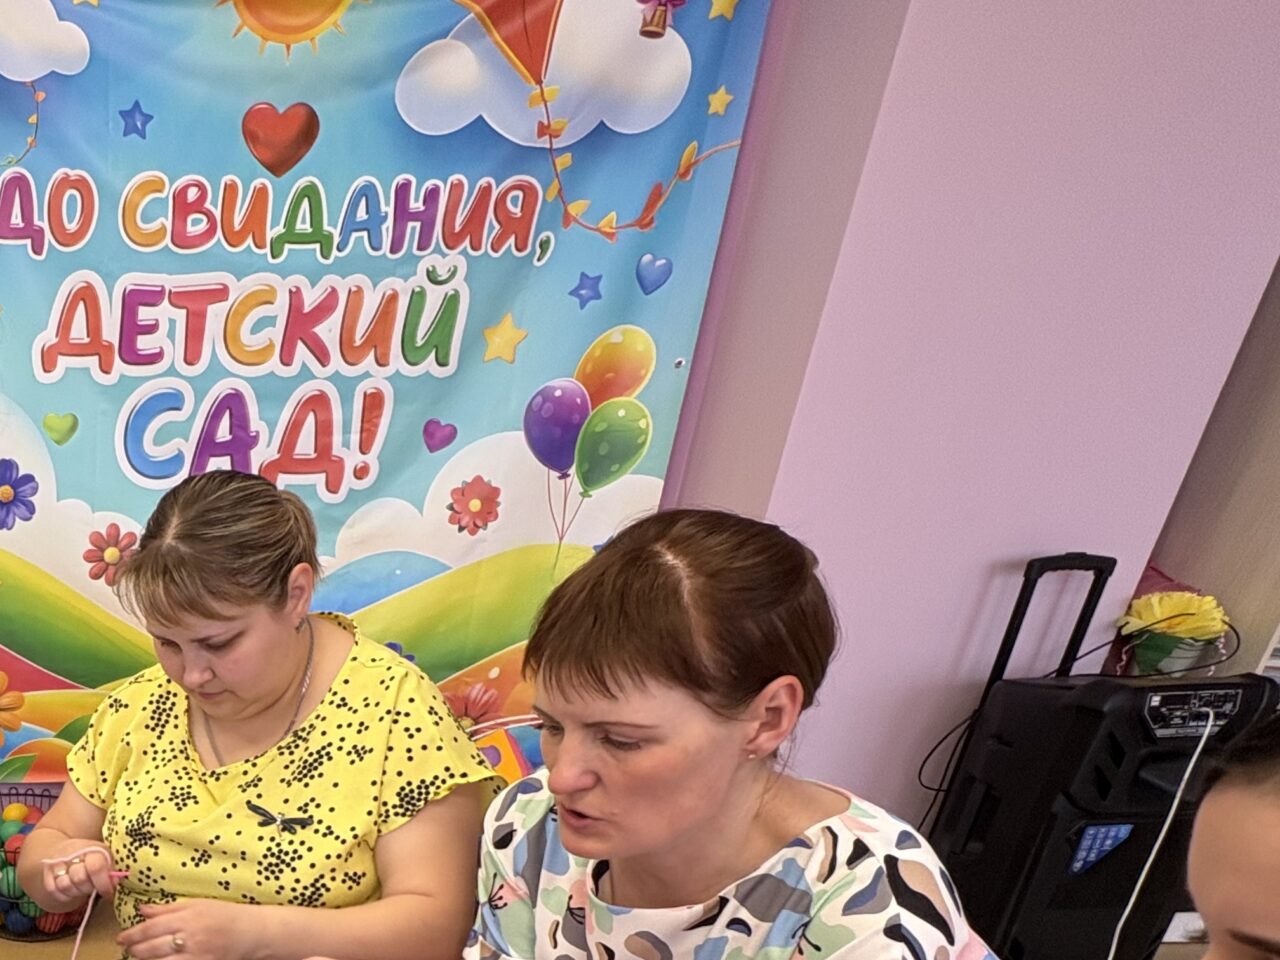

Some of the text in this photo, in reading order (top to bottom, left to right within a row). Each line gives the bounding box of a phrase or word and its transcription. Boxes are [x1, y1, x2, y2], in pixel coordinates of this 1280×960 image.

[121, 174, 552, 262] СВИДАНИЯ,
[40, 263, 466, 375] ДЕТСКИЙ
[122, 386, 386, 495] САД!
